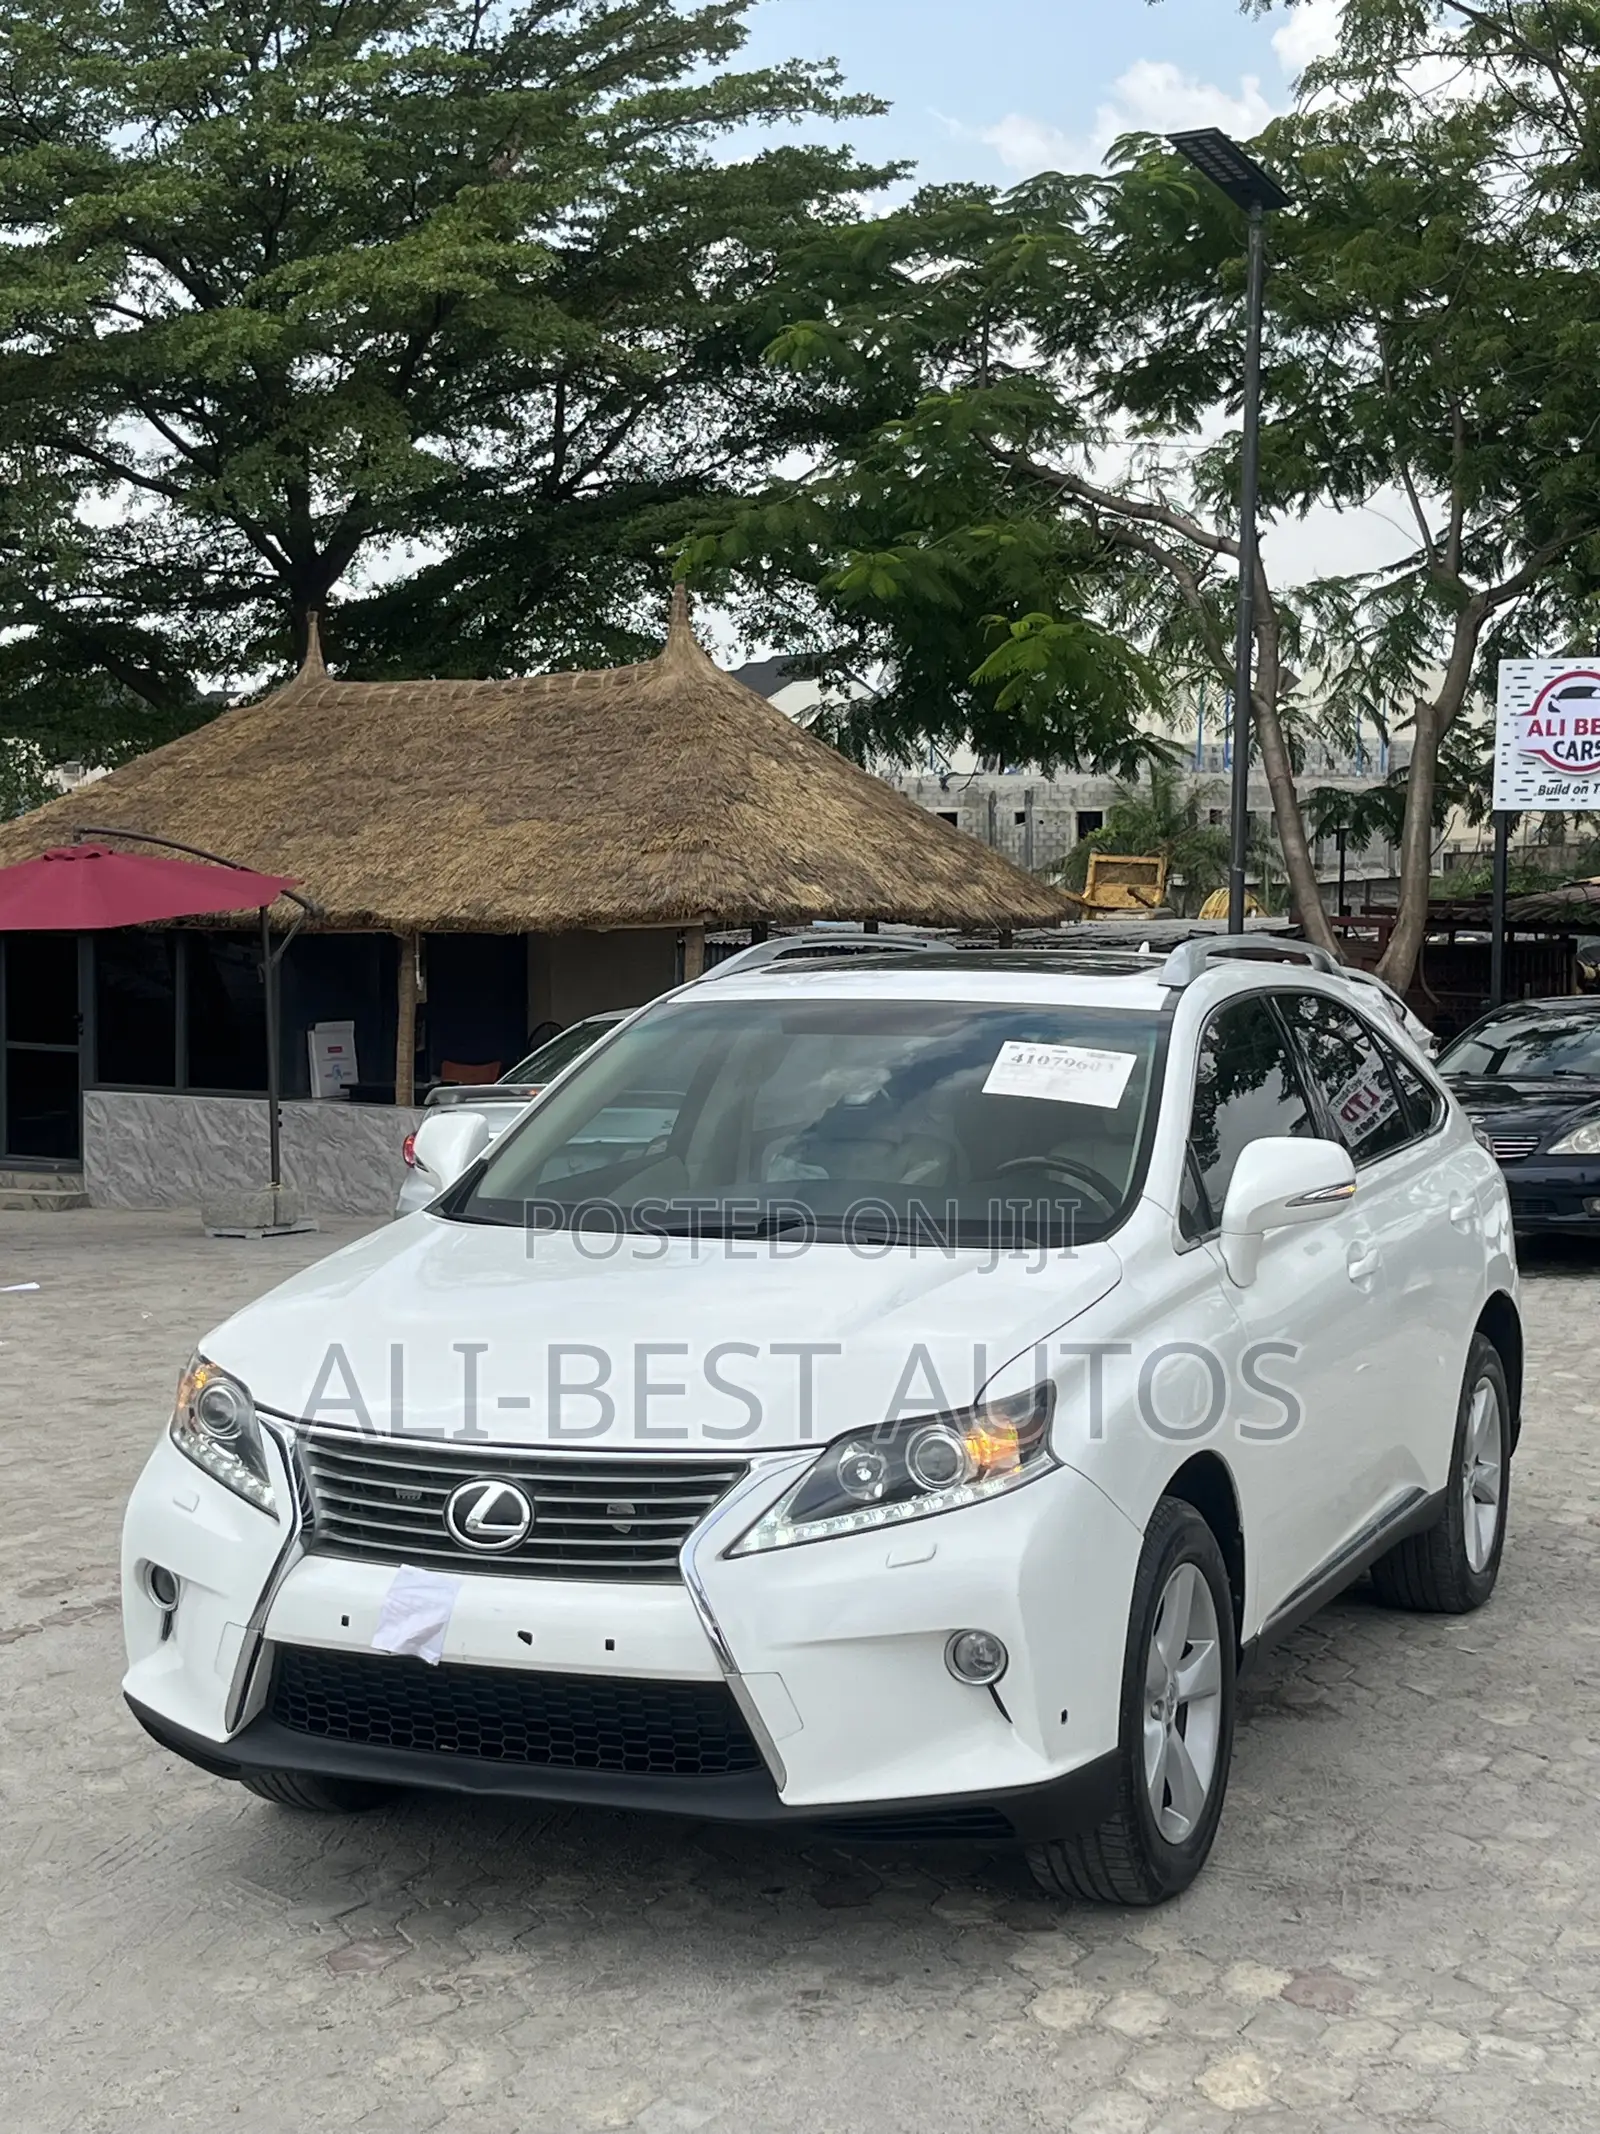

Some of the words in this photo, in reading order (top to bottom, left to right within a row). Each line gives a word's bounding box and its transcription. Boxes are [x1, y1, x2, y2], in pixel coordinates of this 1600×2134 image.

[1527, 719, 1566, 737] ALI
[1537, 783, 1571, 796] Build
[1572, 785, 1589, 795] on
